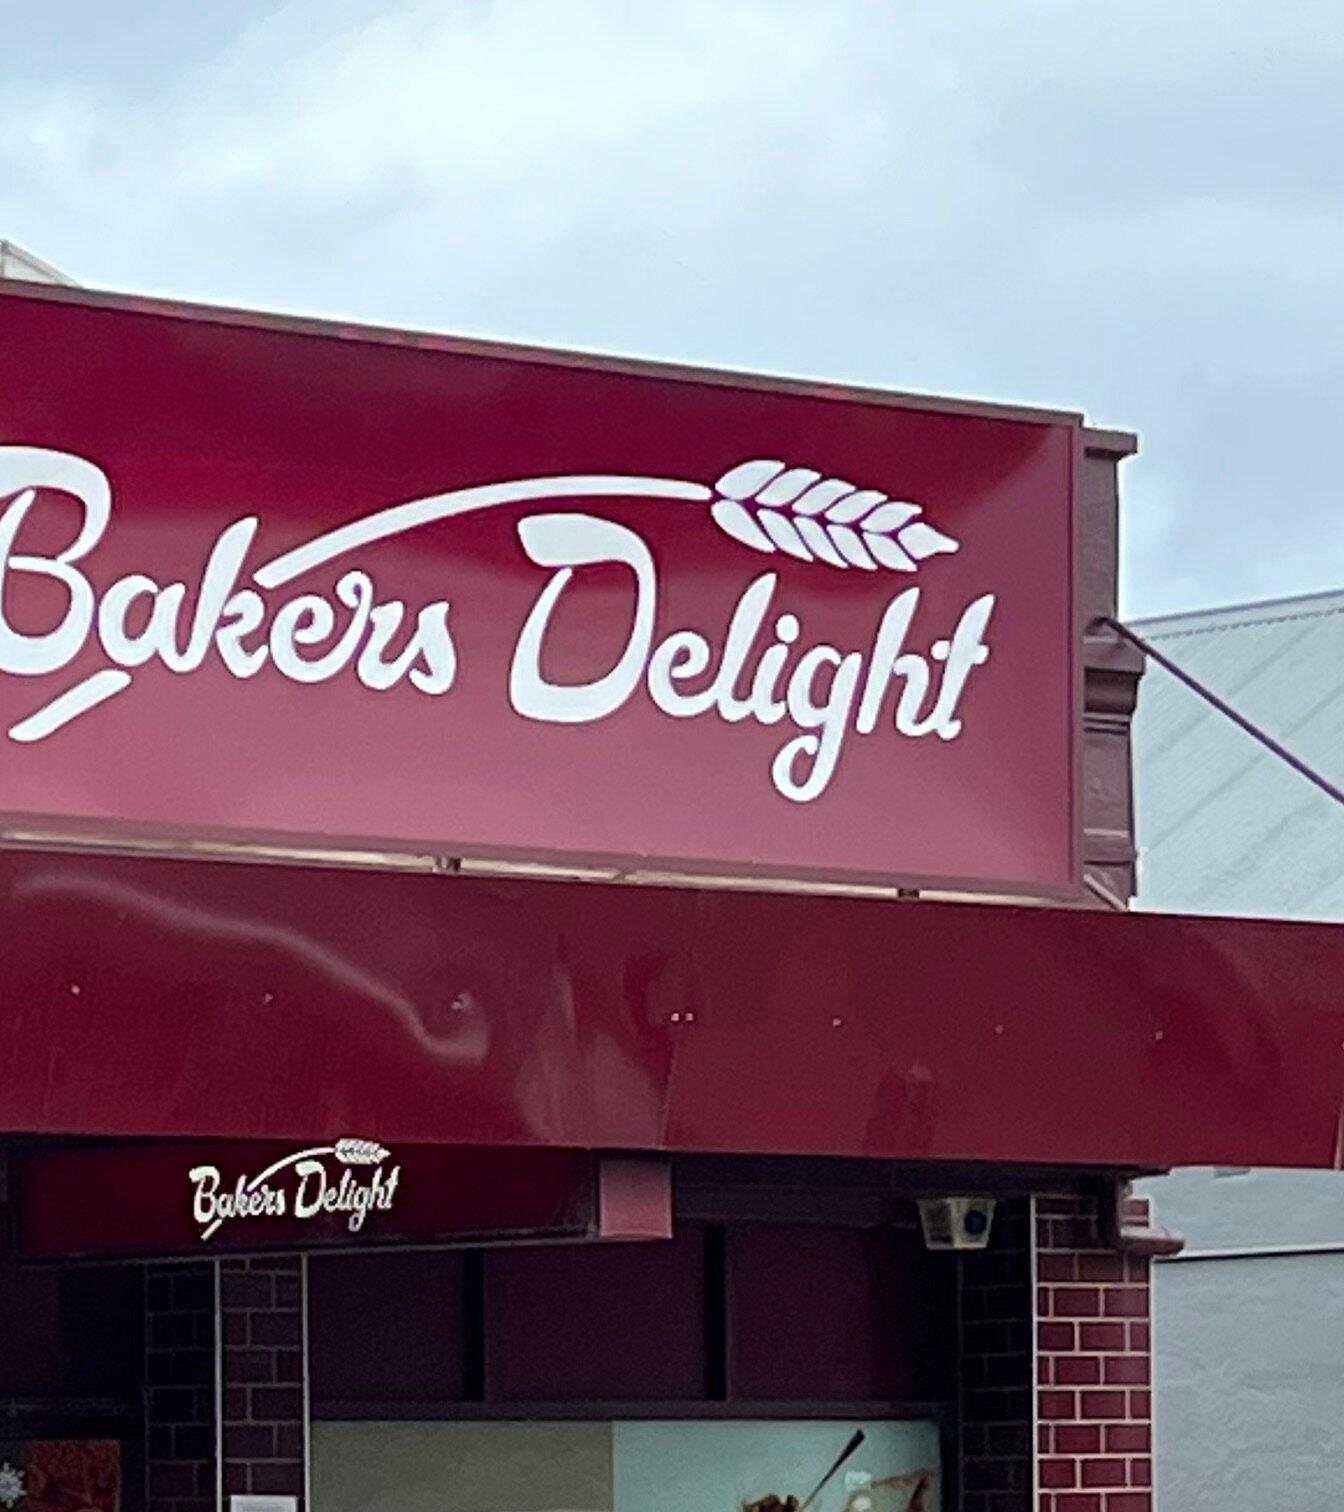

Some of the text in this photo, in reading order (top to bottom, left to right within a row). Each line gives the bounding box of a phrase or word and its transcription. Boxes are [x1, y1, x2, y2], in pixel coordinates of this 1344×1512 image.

[509, 511, 995, 802] Delight
[188, 1159, 401, 1232] Bakers Delight
